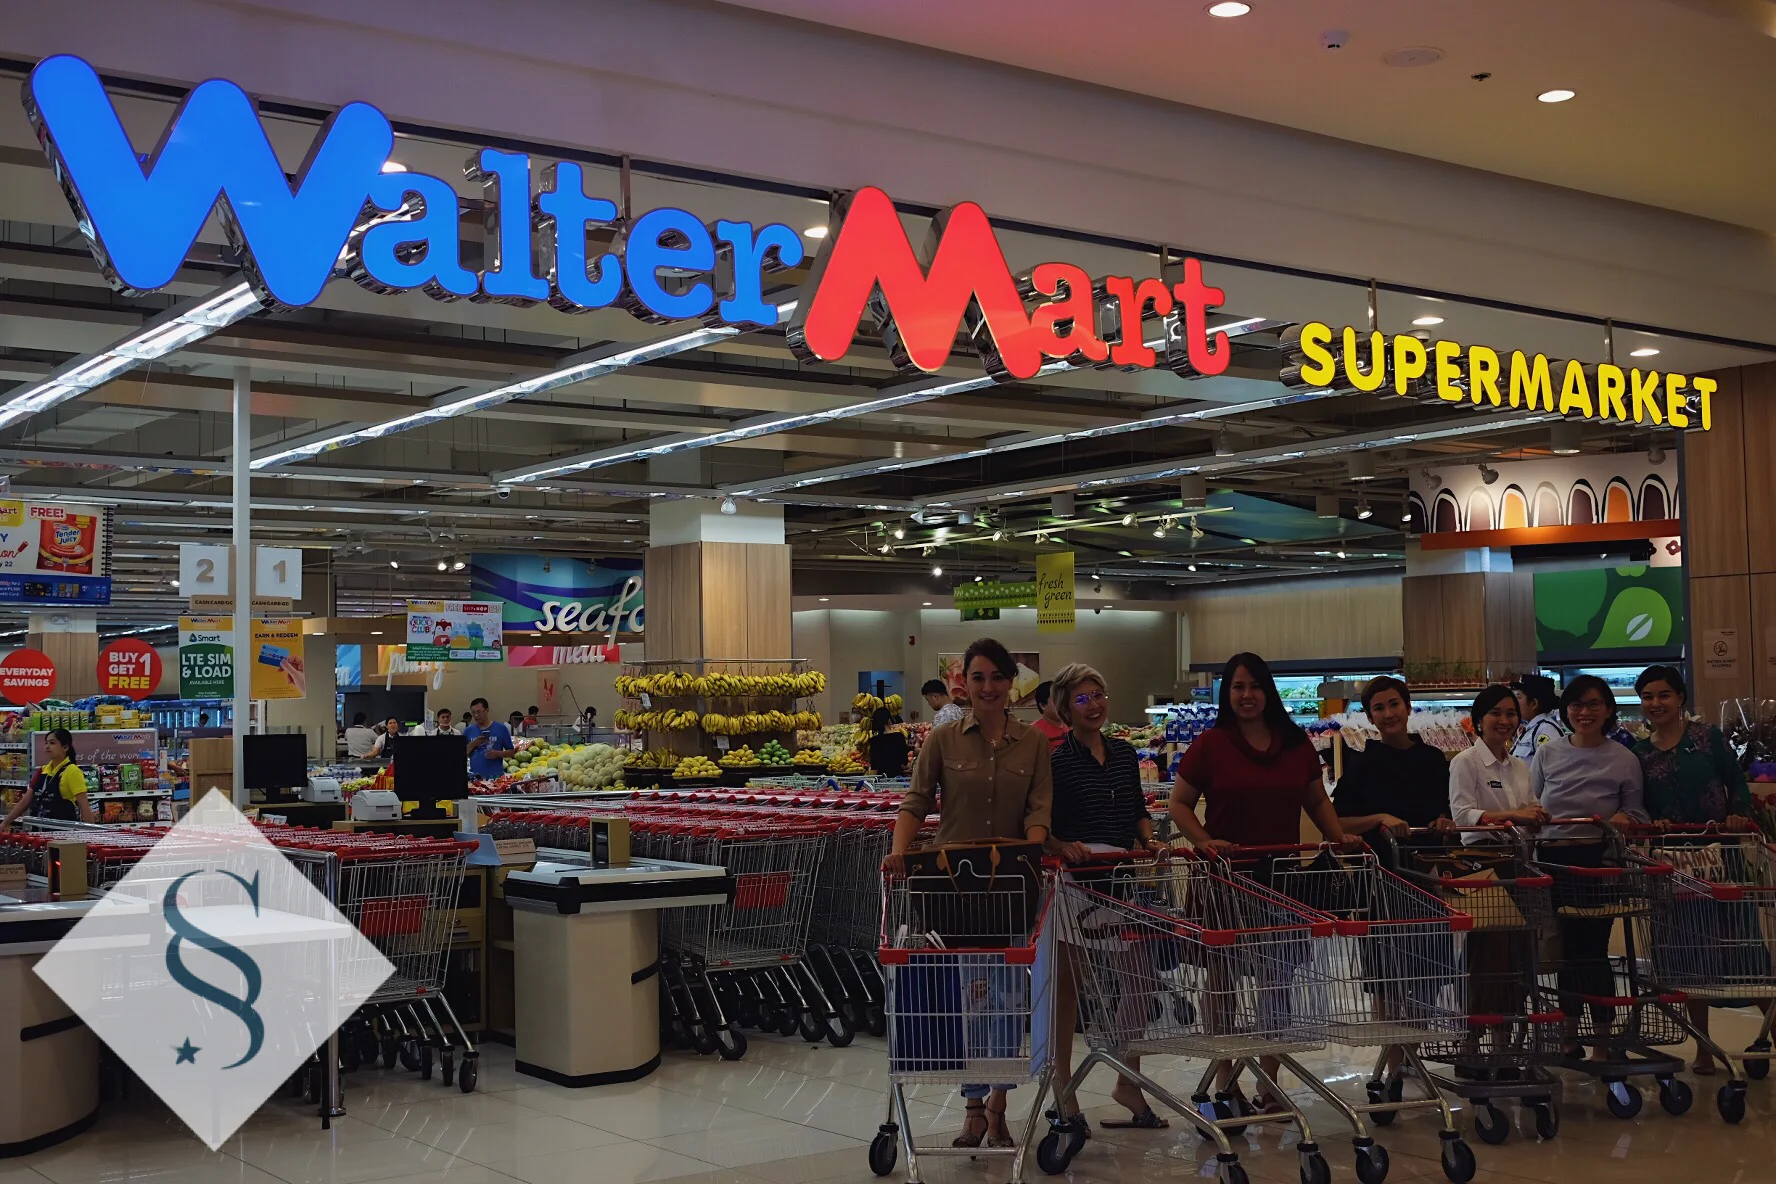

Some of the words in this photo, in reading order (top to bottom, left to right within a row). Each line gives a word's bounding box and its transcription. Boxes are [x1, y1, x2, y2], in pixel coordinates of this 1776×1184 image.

[1299, 321, 1718, 432] SUPERMARKET
[31, 507, 65, 518] FREE!
[56, 530, 80, 539] Tender
[59, 536, 78, 545] Juicy
[196, 559, 214, 582] 2
[273, 560, 286, 583] 1
[1039, 572, 1064, 595] fresh
[1044, 591, 1072, 609] green
[109, 652, 138, 663] BUY
[139, 652, 151, 675] 1
[182, 653, 204, 665] LTE
[207, 653, 231, 665] SIM
[0, 667, 54, 678] EVERYDAY
[108, 664, 136, 675] GET
[182, 667, 191, 678] &
[195, 666, 232, 678] LOAD
[3, 677, 49, 687] SAVINGS
[108, 676, 150, 690] FREE
[87, 748, 100, 763] of
[101, 750, 116, 760] the
